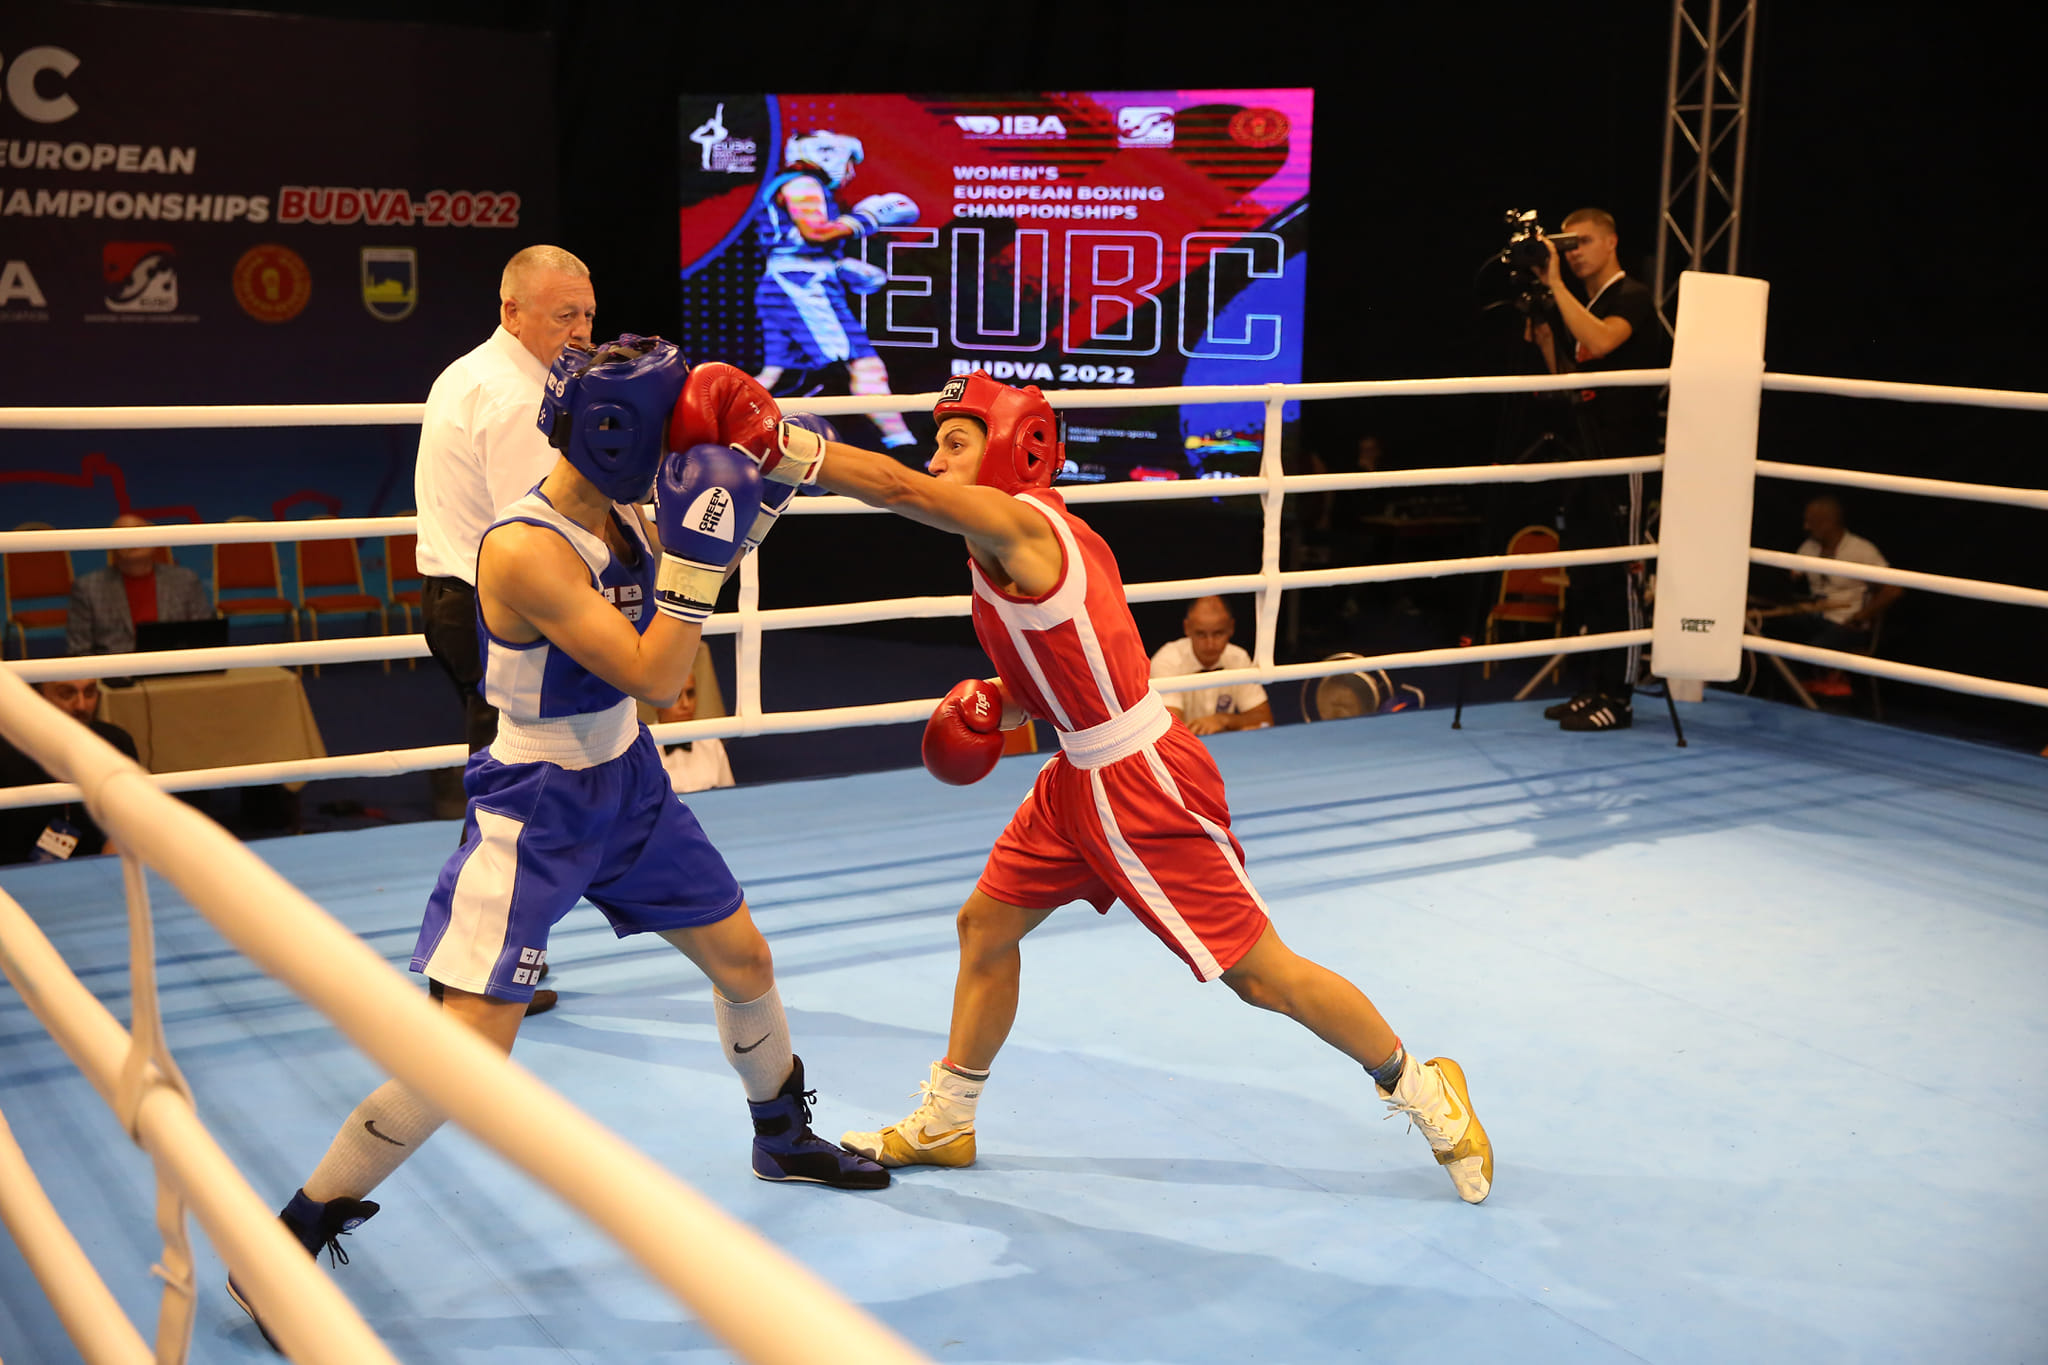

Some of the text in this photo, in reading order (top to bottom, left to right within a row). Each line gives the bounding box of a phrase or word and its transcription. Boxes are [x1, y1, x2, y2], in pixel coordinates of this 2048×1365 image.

[952, 165, 1060, 181] WOMEN'S
[0, 186, 521, 228] AMPIONSHIPS BUDVA-2022
[952, 185, 1165, 201] EUROPEAN BOXING
[952, 203, 1139, 220] CHAMPIONSHIPS
[860, 227, 1285, 361] EUBC
[1058, 363, 1136, 385] 2022
[698, 488, 722, 532] GREEN
[706, 498, 729, 533] HILL
